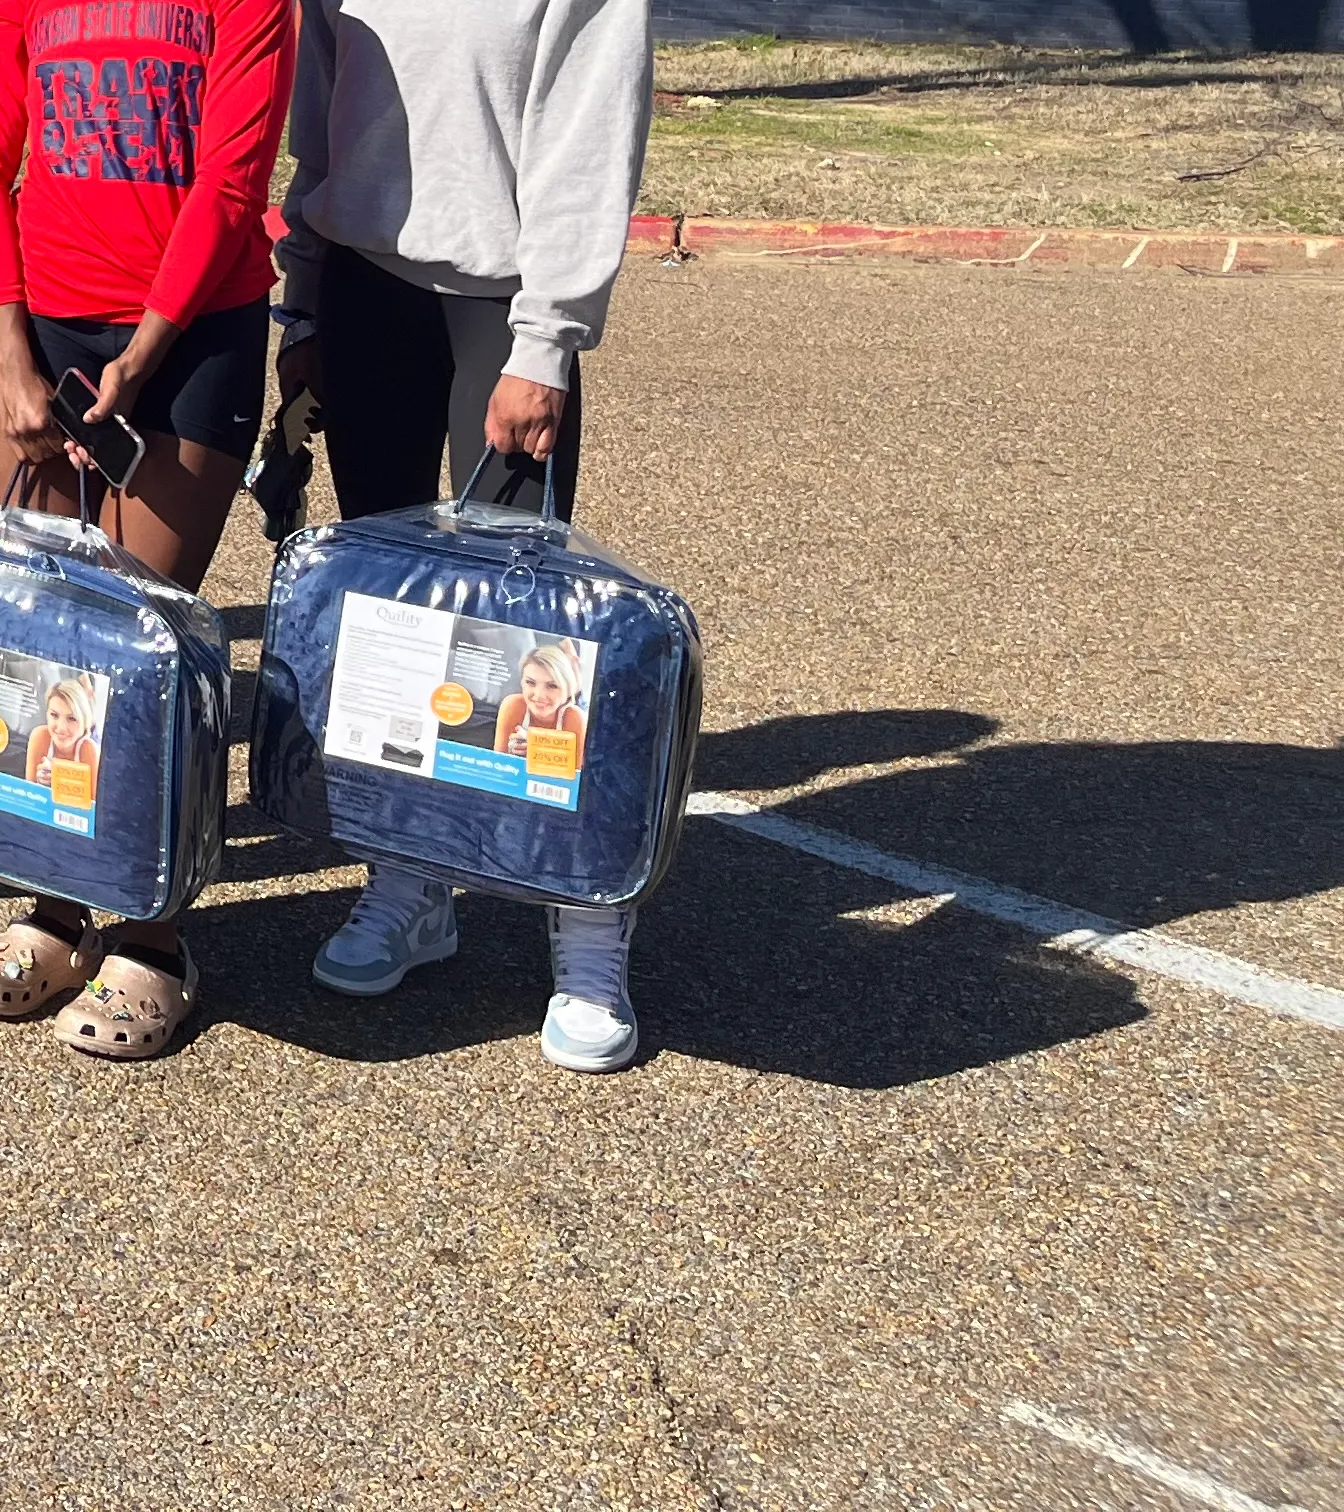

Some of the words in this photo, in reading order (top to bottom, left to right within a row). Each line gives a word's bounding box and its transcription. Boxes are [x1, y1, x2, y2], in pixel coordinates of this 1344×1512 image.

[31, 5, 79, 54] ACKSON
[84, 1, 134, 39] STATE
[35, 57, 205, 126] TRACK
[375, 606, 424, 626] Quility
